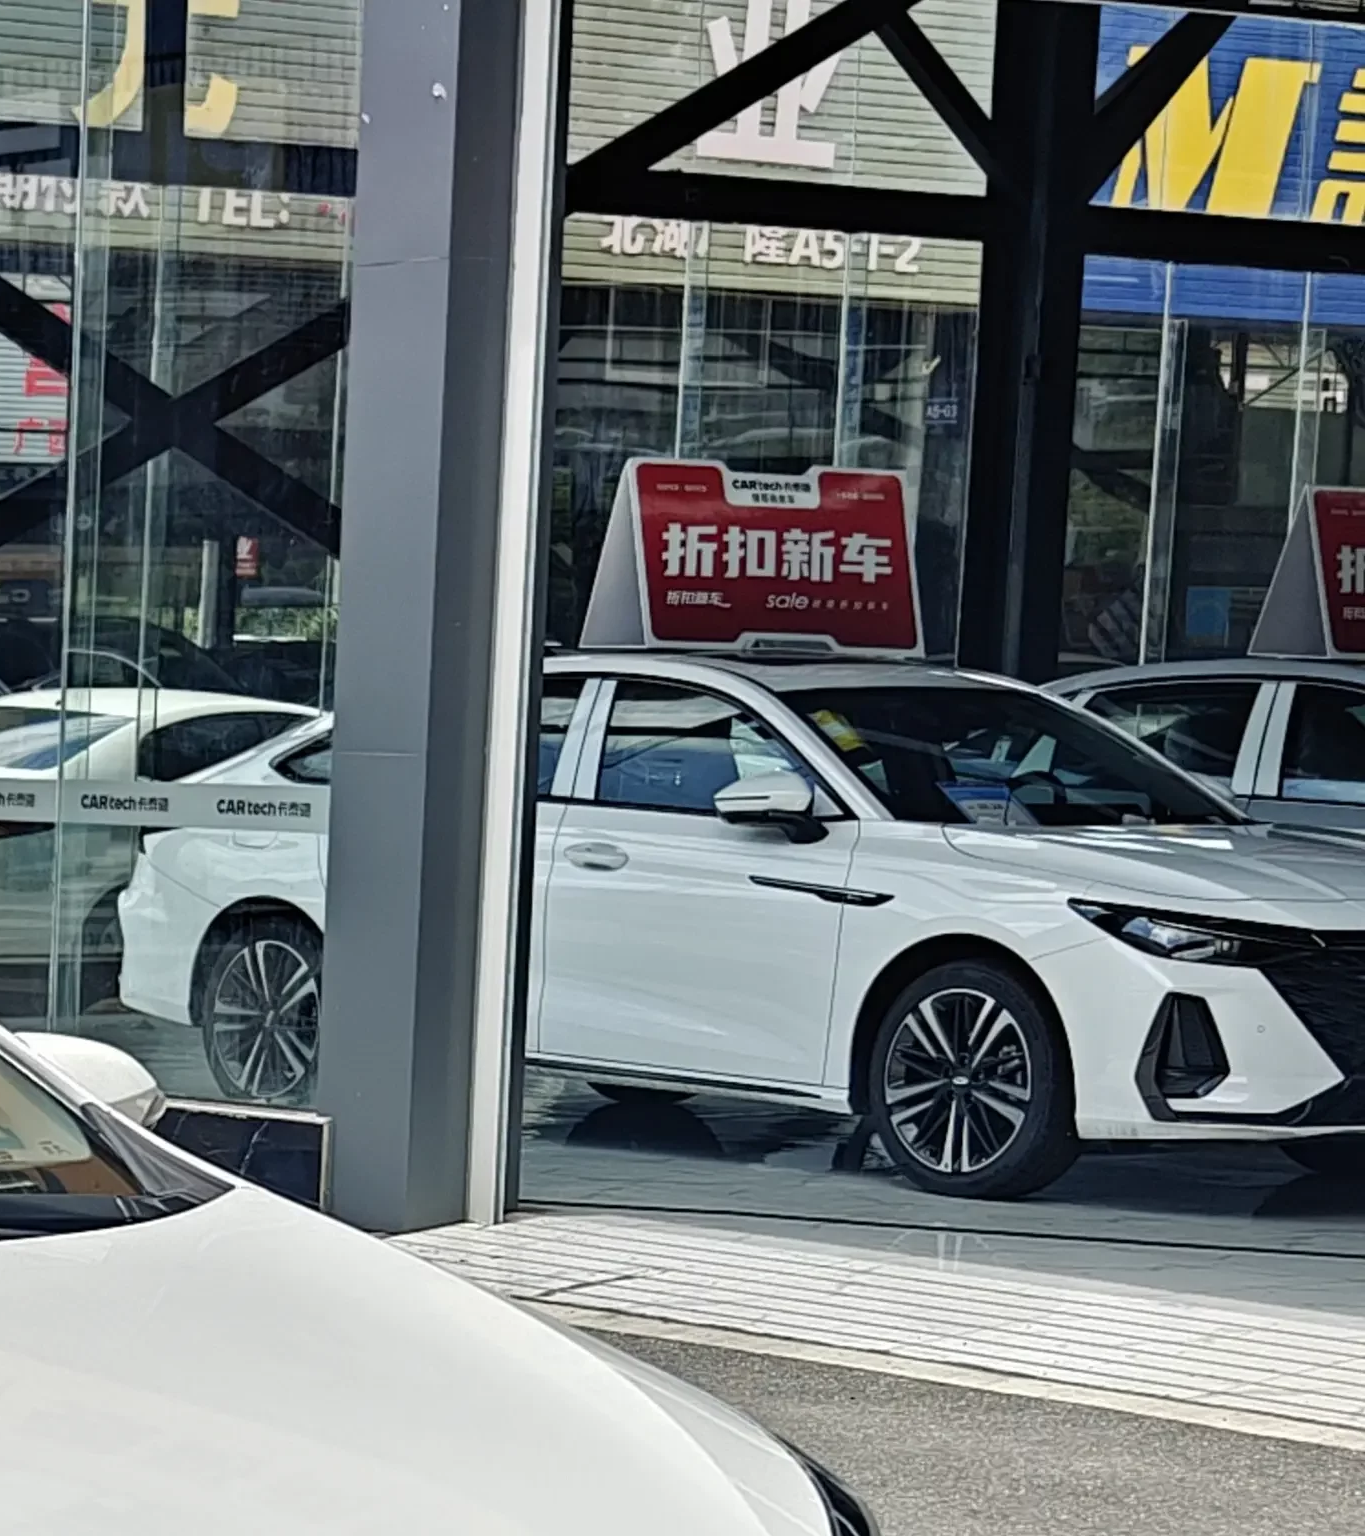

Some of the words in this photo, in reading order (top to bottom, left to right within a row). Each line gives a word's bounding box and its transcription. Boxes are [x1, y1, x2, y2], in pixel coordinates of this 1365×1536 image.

[662, 522, 892, 583] 折扣新车
[765, 592, 809, 610] sale
